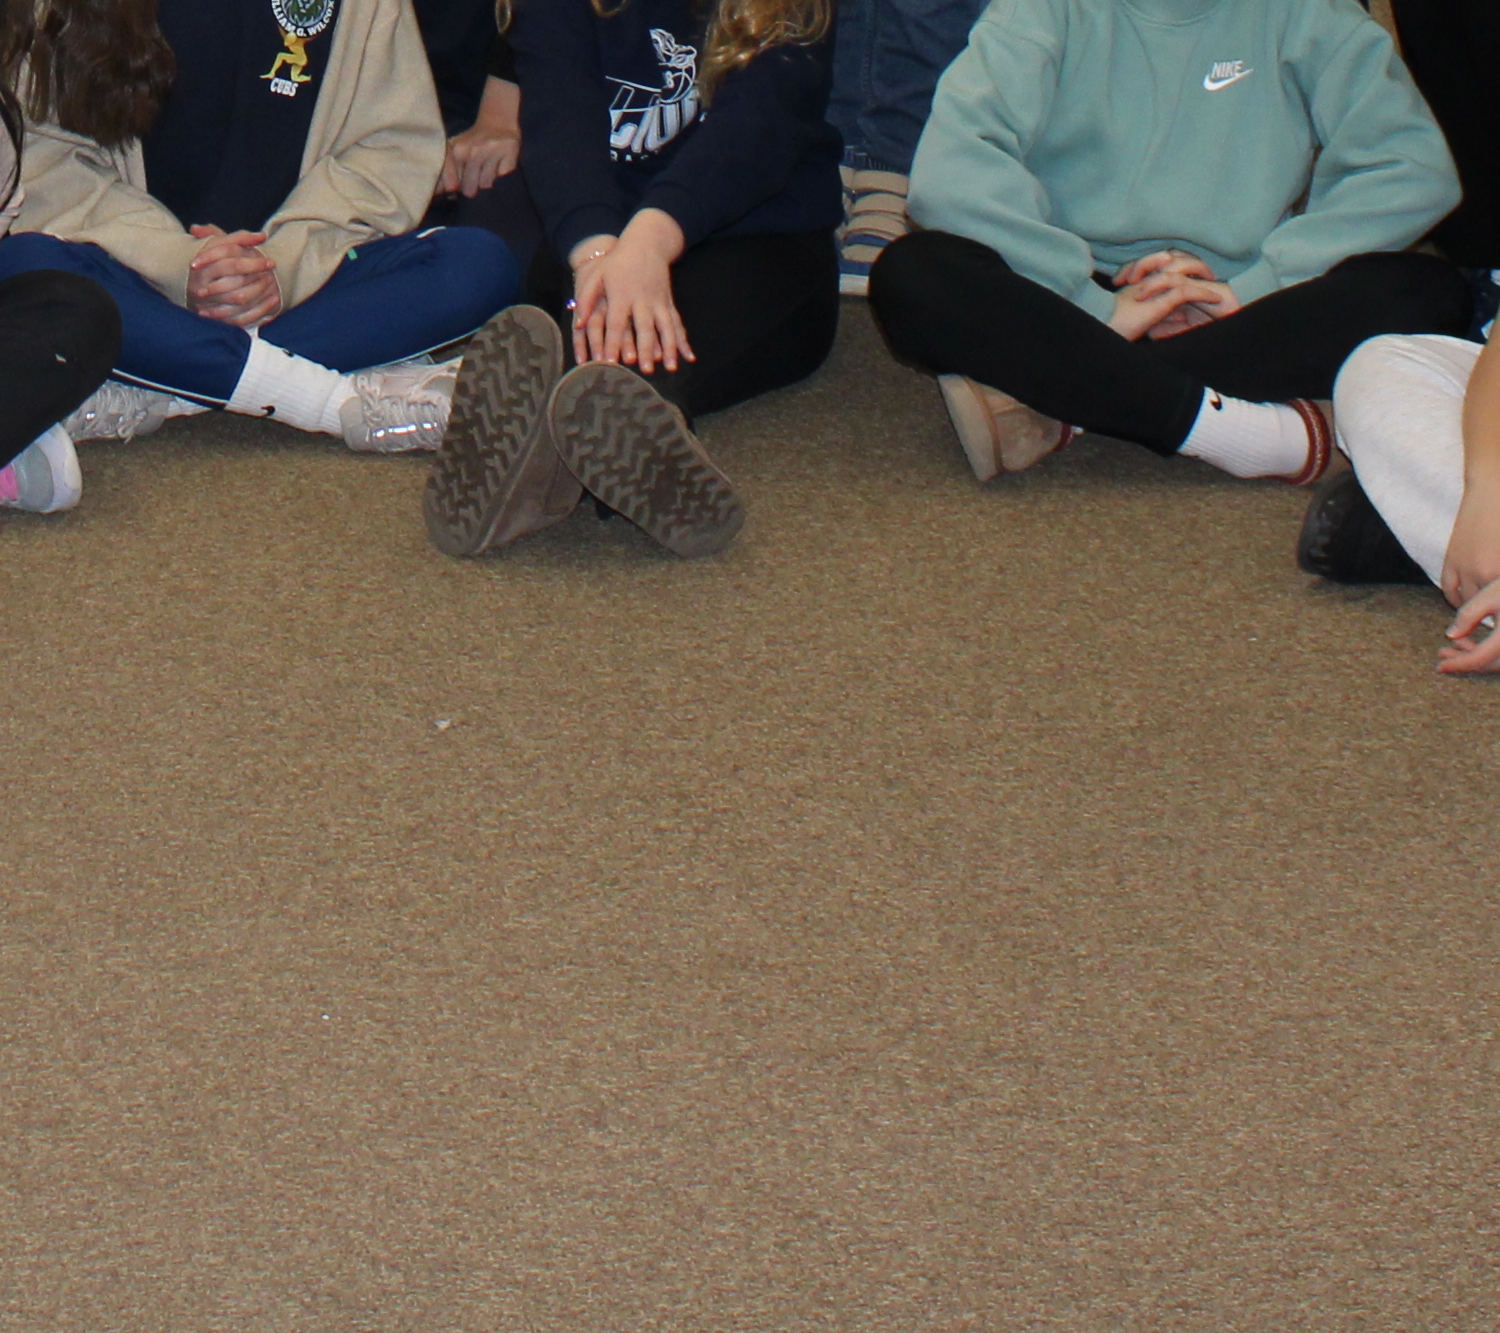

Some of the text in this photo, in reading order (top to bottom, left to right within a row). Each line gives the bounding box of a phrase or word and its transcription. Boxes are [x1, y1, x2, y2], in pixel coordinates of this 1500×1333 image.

[307, 0, 336, 37] WILCOX
[1211, 60, 1243, 78] NIKE
[270, 77, 299, 98] CUBS
